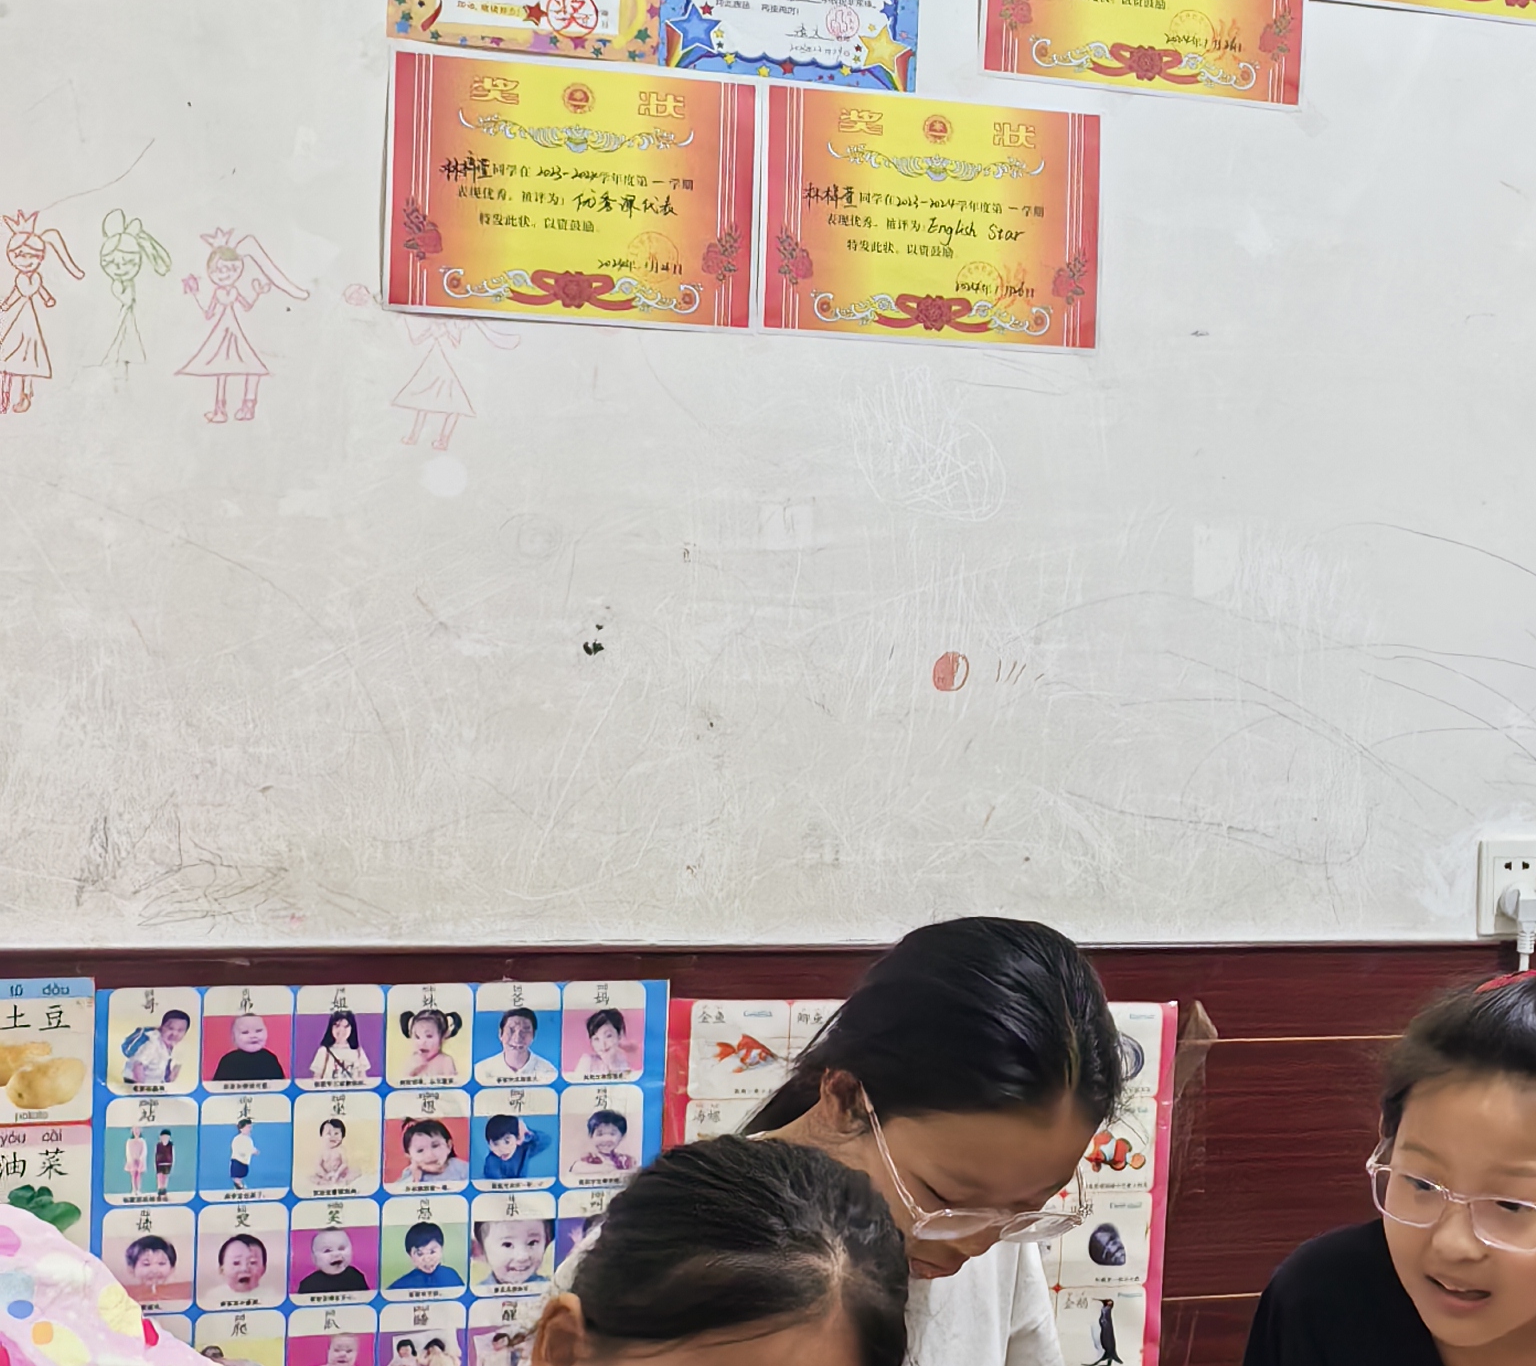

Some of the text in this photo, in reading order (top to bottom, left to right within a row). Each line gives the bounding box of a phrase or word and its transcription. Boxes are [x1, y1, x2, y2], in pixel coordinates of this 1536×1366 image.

[469, 75, 686, 119] 奖 状
[838, 109, 1036, 148] 奖 状
[927, 217, 977, 245] English
[988, 224, 1025, 242] Star
[0, 1005, 71, 1031] 土豆
[0, 1148, 68, 1180] 油菜
